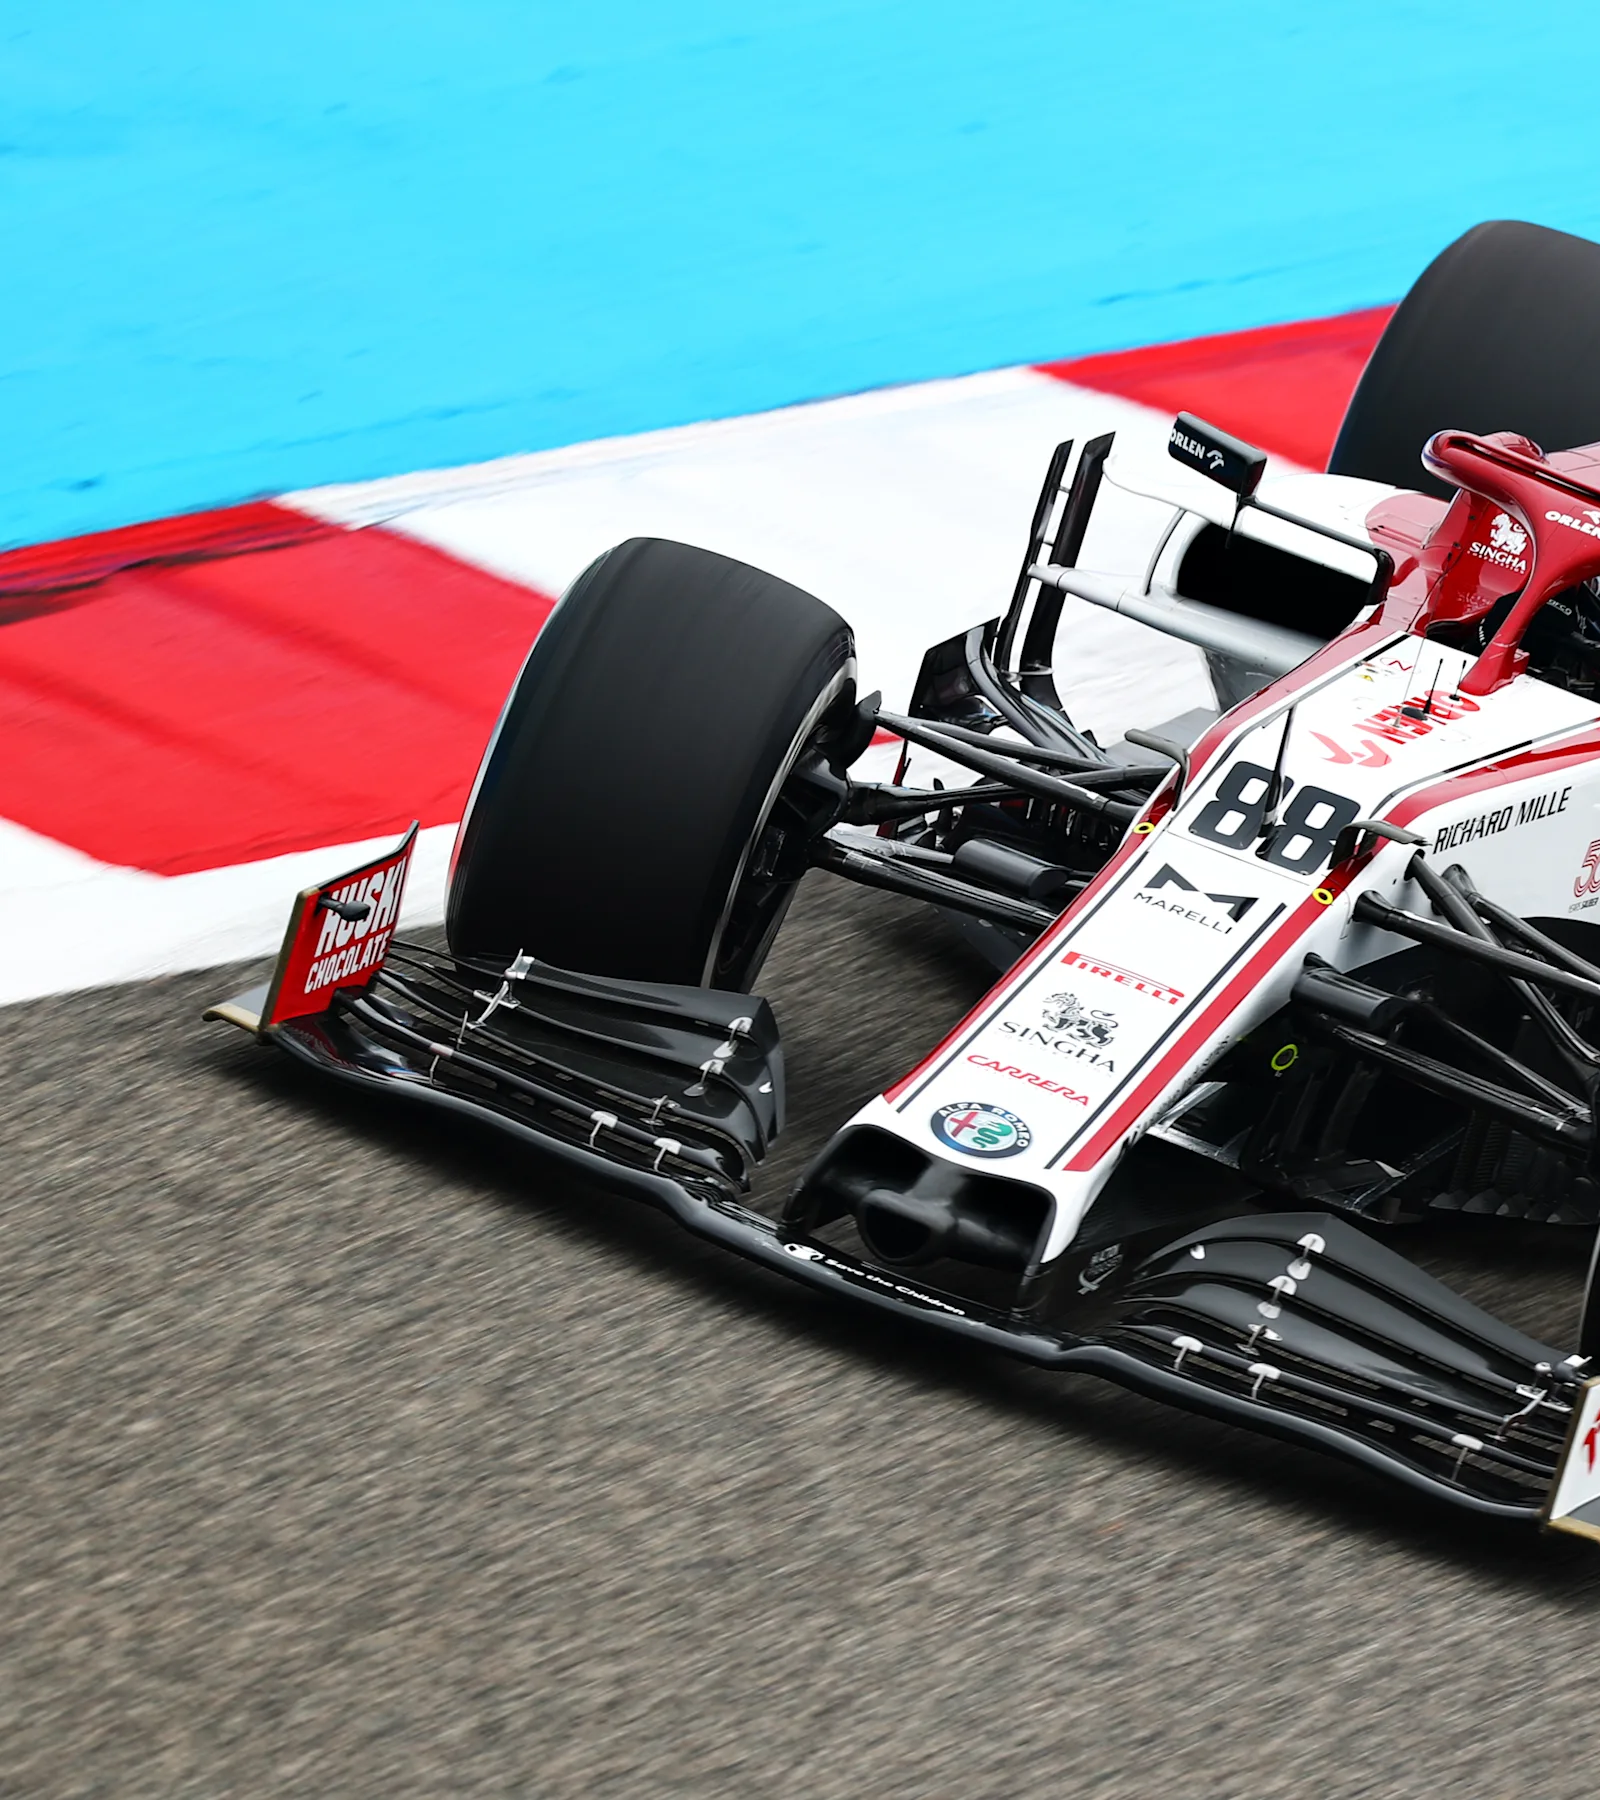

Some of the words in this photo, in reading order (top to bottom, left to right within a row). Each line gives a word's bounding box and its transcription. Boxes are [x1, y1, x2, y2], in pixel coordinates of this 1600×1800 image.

[1170, 428, 1206, 460] ORLEN
[1469, 541, 1528, 571] SINGHA
[1188, 760, 1362, 876] 88
[1433, 806, 1513, 854] RICHARD
[1514, 786, 1573, 827] MILLE
[314, 856, 407, 959] HUSKI
[1133, 892, 1233, 935] MARELLI
[304, 929, 391, 994] CHOCOLATE
[1060, 951, 1185, 1006] PIRELLI
[998, 1021, 1115, 1073] SINGHA
[967, 1054, 1090, 1106] CARRERA
[938, 1103, 983, 1118] ALFA
[991, 1107, 1029, 1148] ROMEO
[825, 1258, 866, 1277] Save
[866, 1274, 895, 1288] the
[895, 1285, 966, 1316] Children
